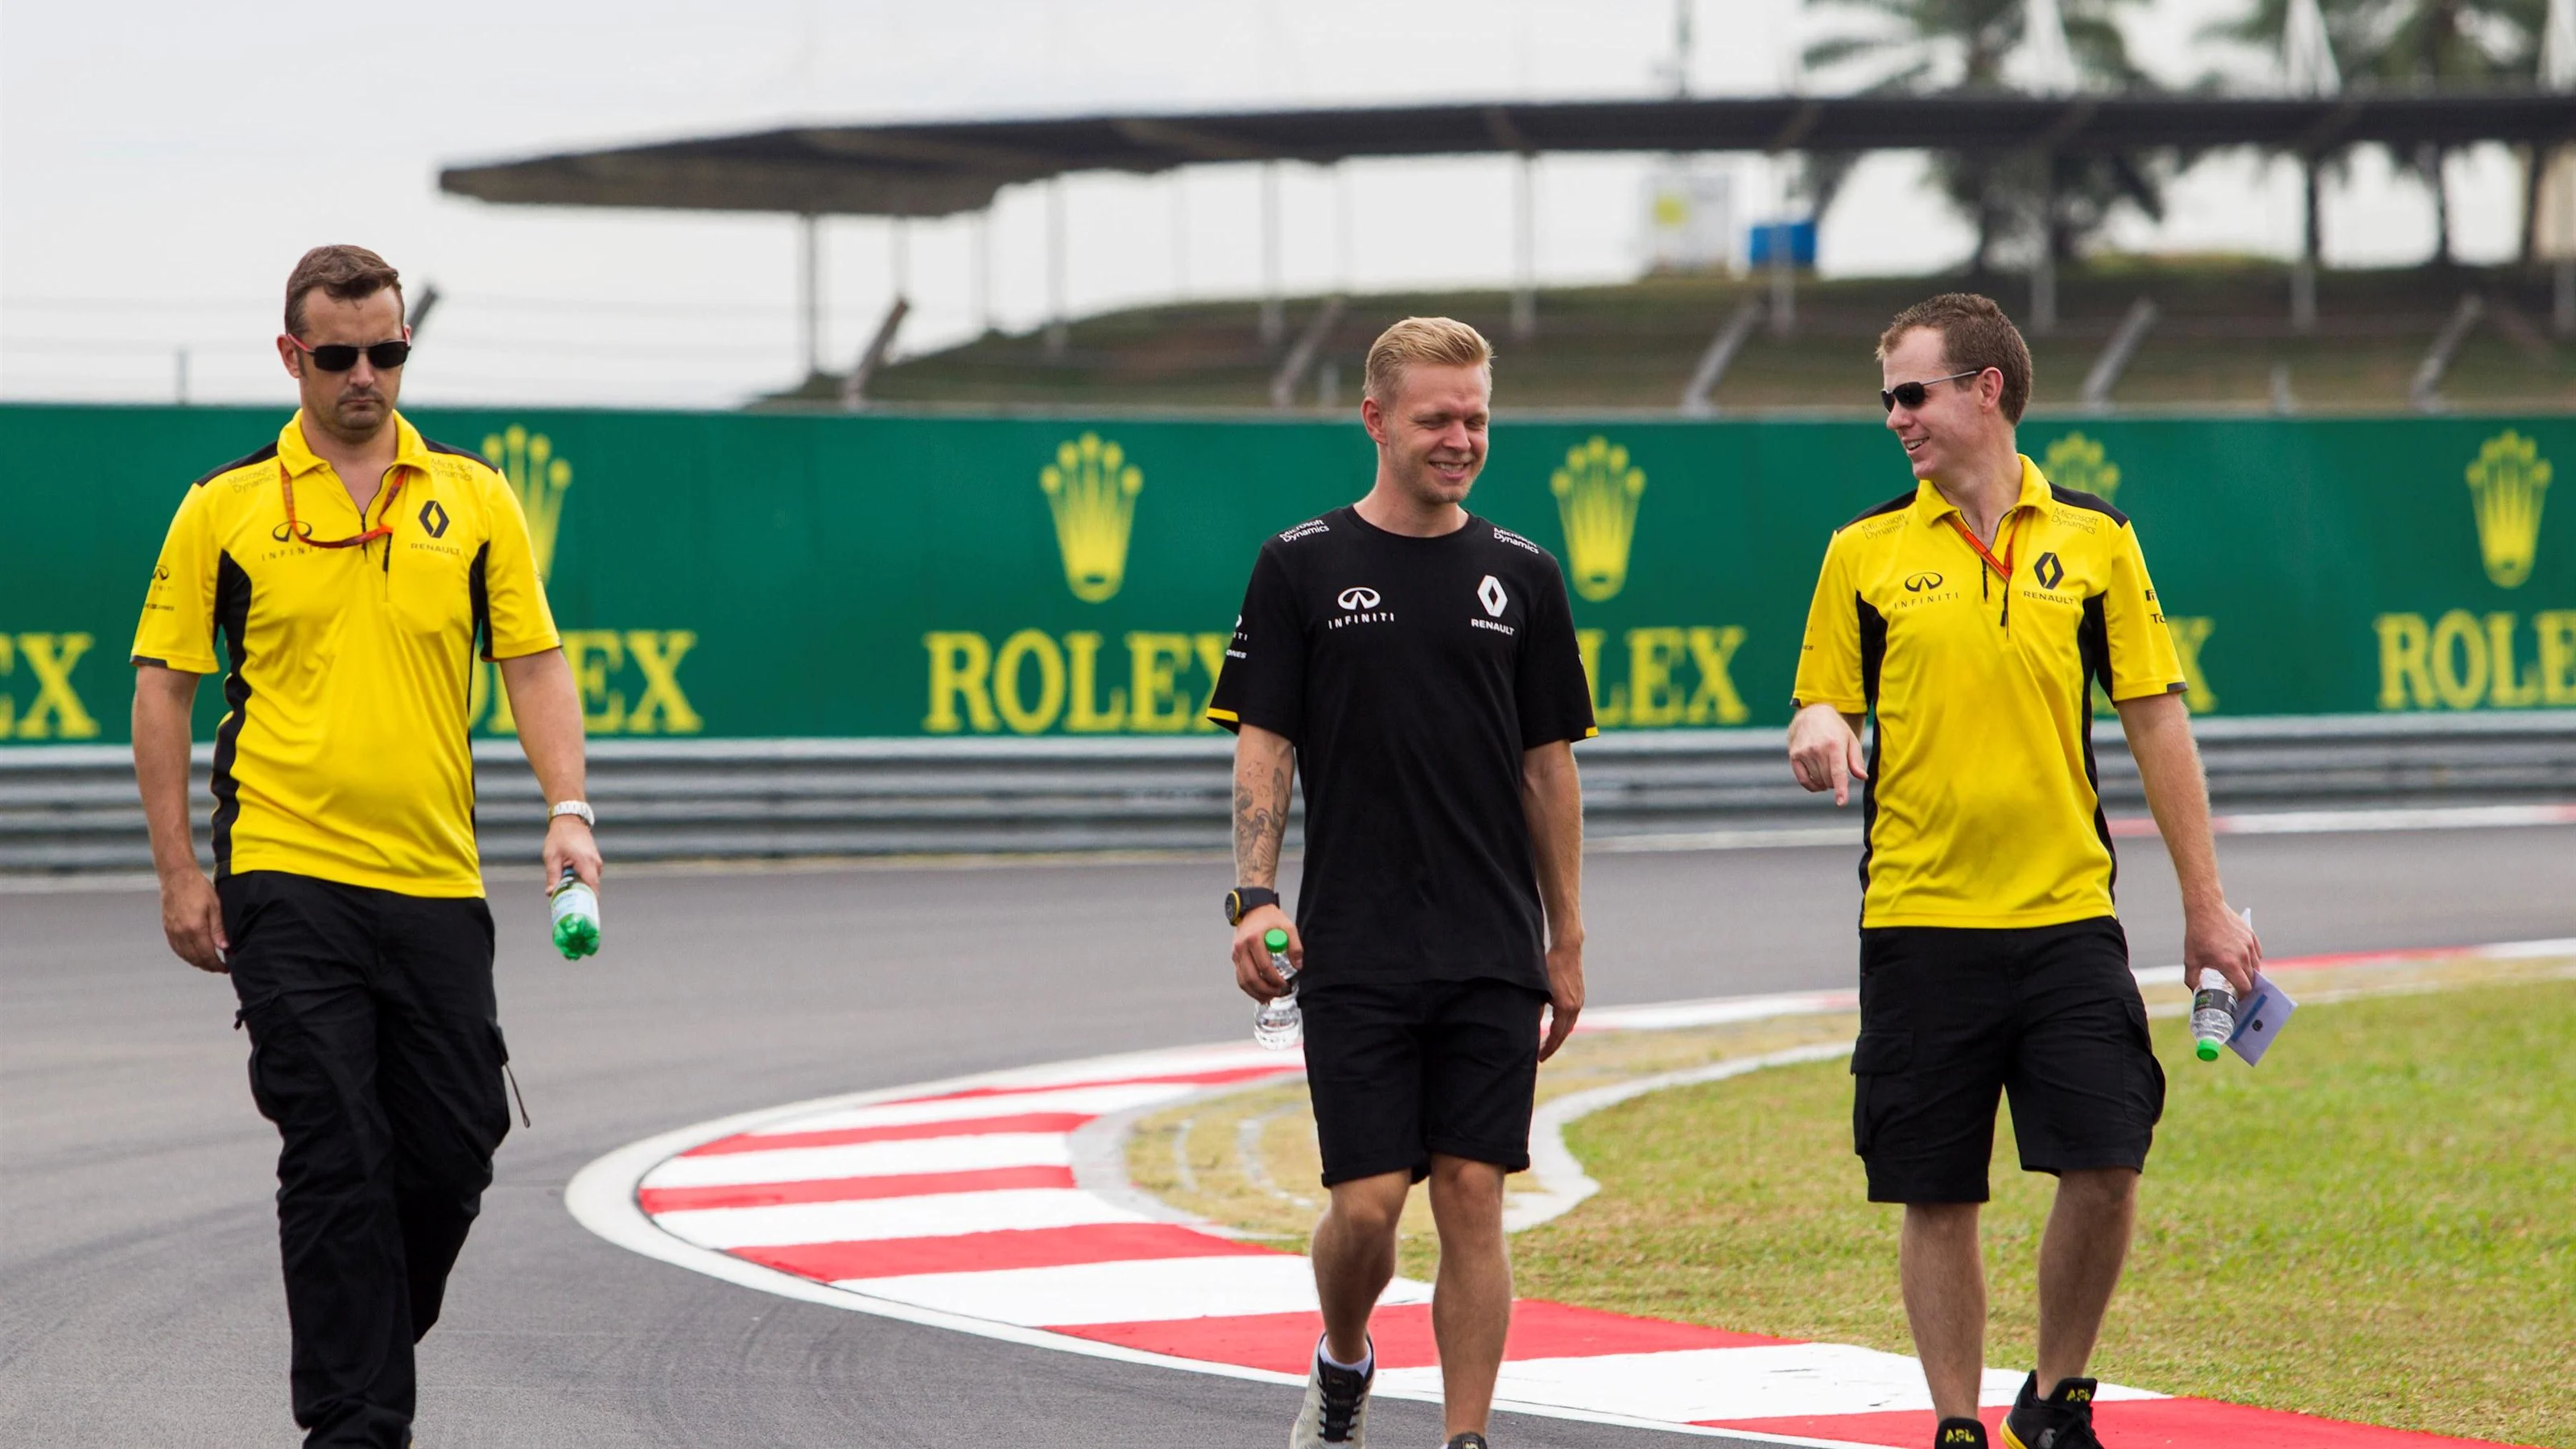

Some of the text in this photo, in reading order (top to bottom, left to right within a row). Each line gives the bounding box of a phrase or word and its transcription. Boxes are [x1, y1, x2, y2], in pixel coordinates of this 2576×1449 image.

[1861, 514, 1905, 532] Microsoft
[2051, 515, 2096, 535] Dynamics
[2054, 507, 2099, 525] Microsoft
[1282, 524, 1330, 543] Dynamics
[411, 543, 460, 556] RENAULT
[1493, 531, 1540, 555] Dynamics
[262, 546, 324, 562] INFINI
[1894, 592, 1959, 610] INFINITI
[2023, 590, 2074, 605] RENAULT
[1328, 612, 1395, 630] INFINITI
[1471, 617, 1516, 637] RENAULT
[0, 631, 101, 741] X
